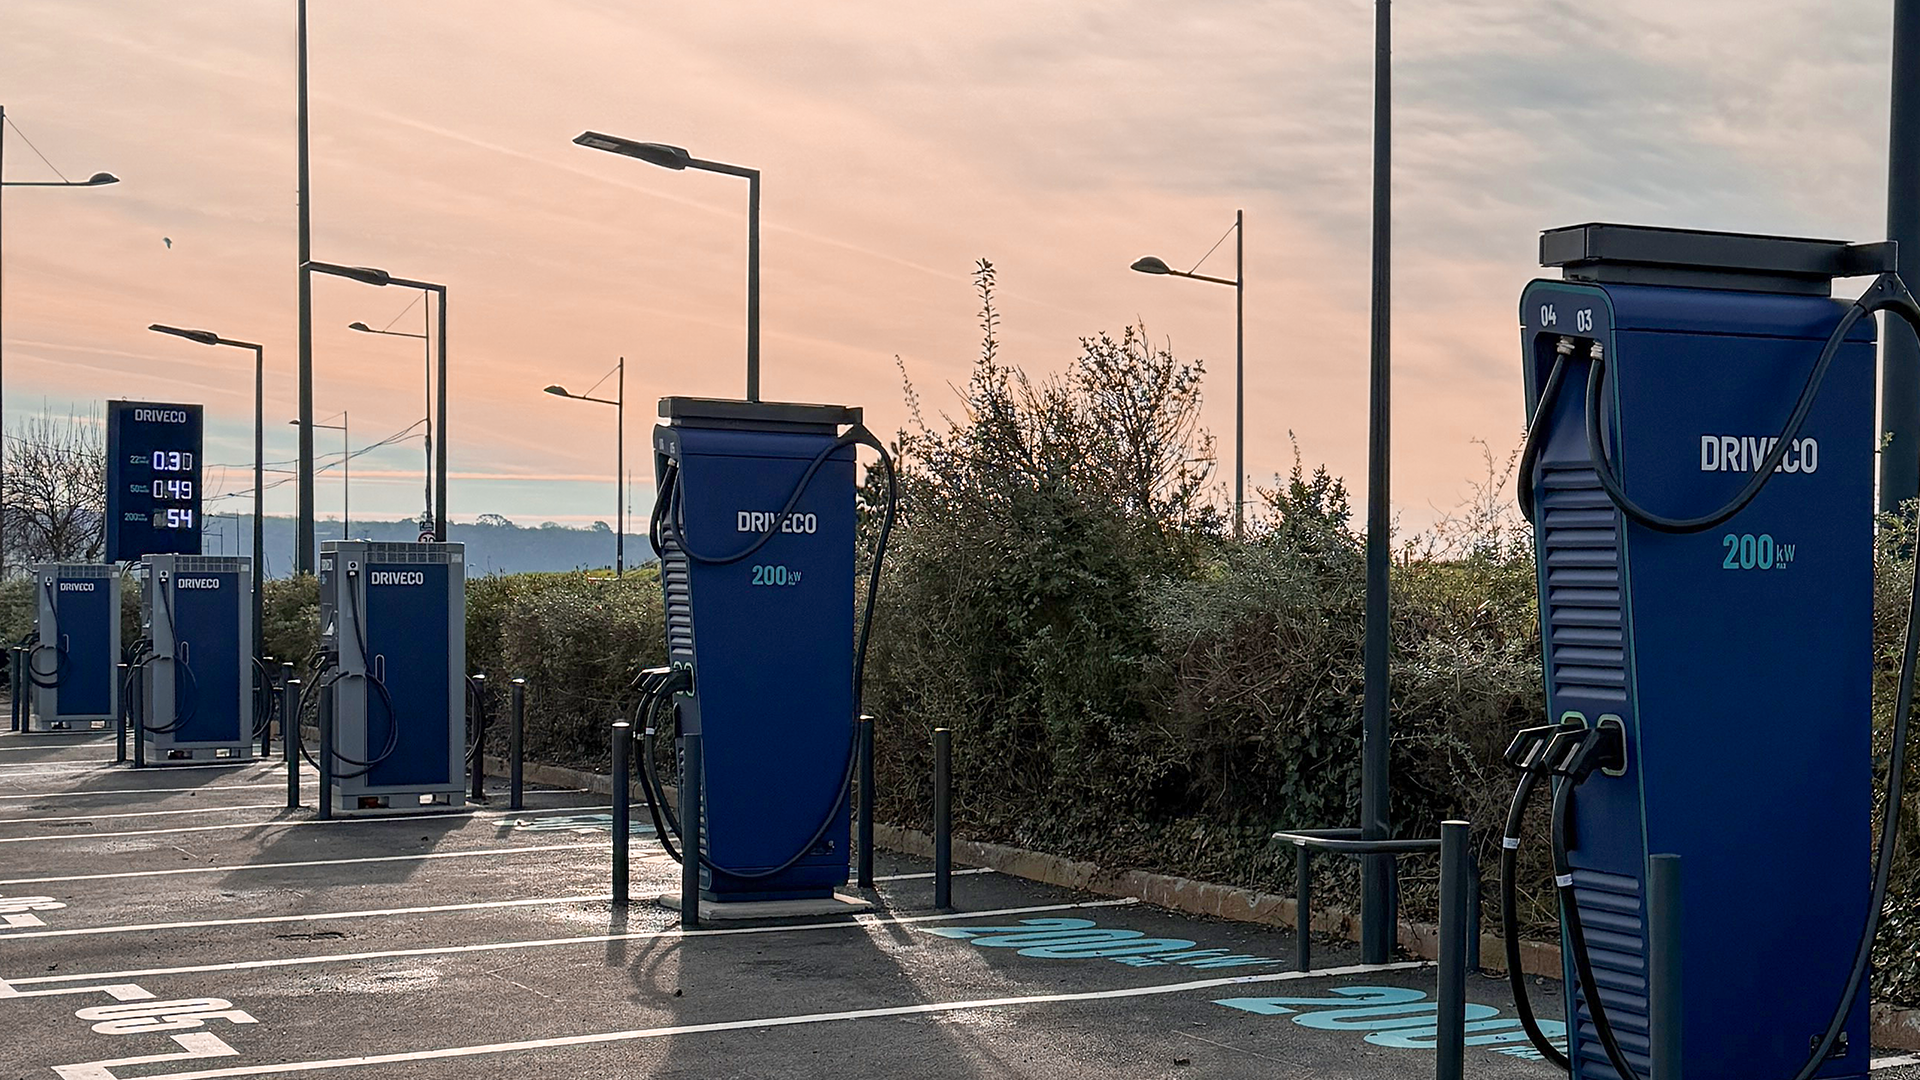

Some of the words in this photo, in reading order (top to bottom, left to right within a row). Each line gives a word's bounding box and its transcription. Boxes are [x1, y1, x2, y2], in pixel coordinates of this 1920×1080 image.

[1541, 304, 1557, 327] 04
[1577, 309, 1593, 332] 03
[134, 409, 187, 424] DRIVECO
[153, 480, 192, 499] 0.49
[1723, 533, 1774, 570] 200
[1776, 544, 1795, 562] kW
[178, 578, 220, 589] DRIVECO
[371, 571, 424, 585] DRIVECO
[752, 565, 787, 585] 200
[788, 571, 802, 582] kW
[60, 582, 94, 592] DRIVECO
[918, 918, 1197, 959] 200
[1210, 986, 1566, 1049] 200
